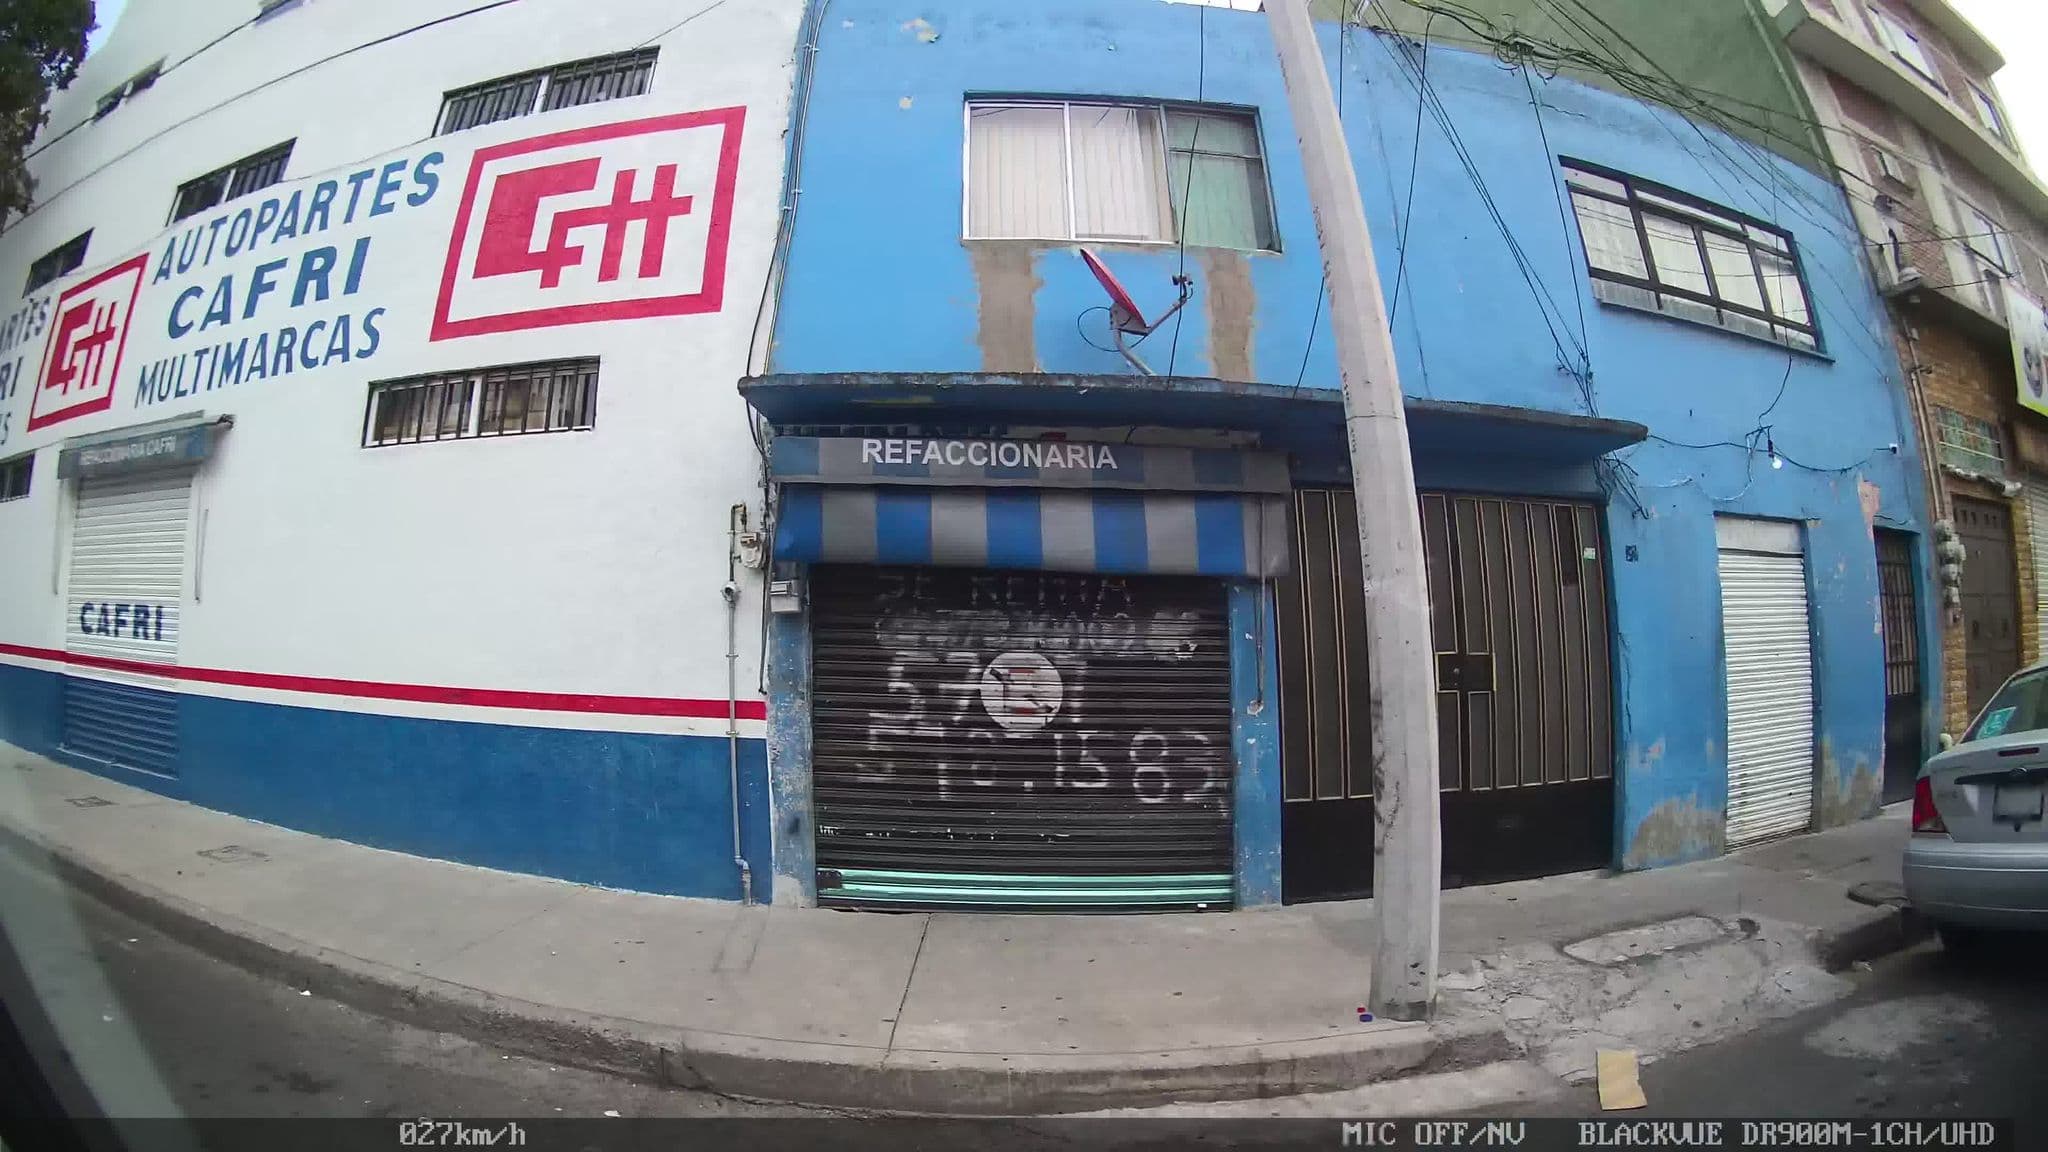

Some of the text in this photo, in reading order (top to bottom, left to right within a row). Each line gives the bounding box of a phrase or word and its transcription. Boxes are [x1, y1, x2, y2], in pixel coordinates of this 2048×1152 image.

[152, 151, 444, 285] AUTOPARTES
[168, 236, 371, 339] CAFRI
[134, 307, 386, 409] MULTIMARCAS
[861, 438, 1118, 470] REFACCIONARIA
[80, 602, 164, 641] CAFRI
